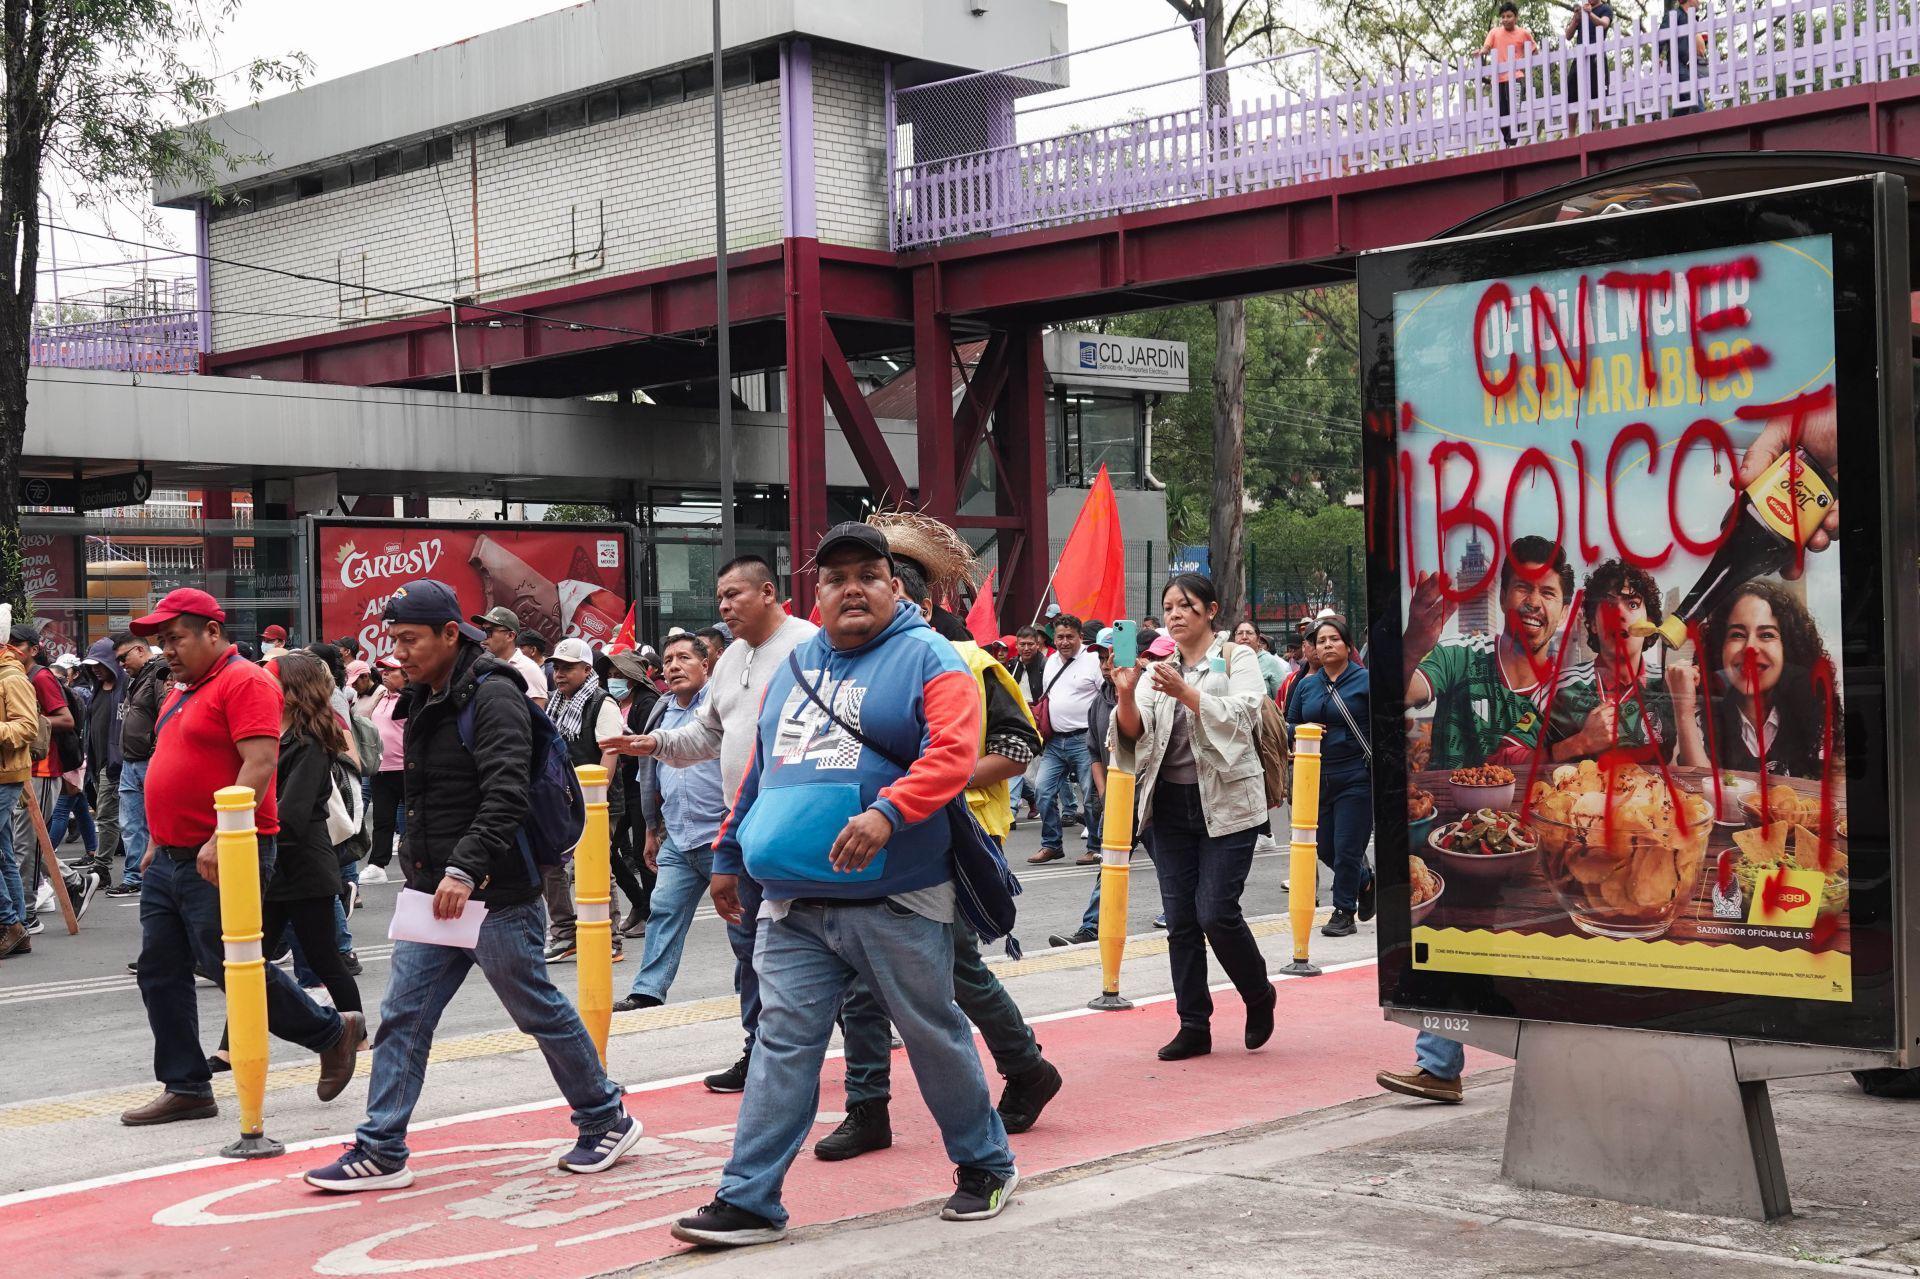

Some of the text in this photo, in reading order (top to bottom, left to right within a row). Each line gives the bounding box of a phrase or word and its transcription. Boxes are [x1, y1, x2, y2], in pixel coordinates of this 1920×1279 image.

[1474, 256, 1770, 398] CNTE
[1100, 343, 1184, 369] CD. JARDÍN
[1778, 893, 1805, 903] aggi
[1696, 926, 1745, 936] SAZONADOR
[1748, 929, 1777, 938] OFICIAL
[1423, 1016, 1470, 1031] 02 032
